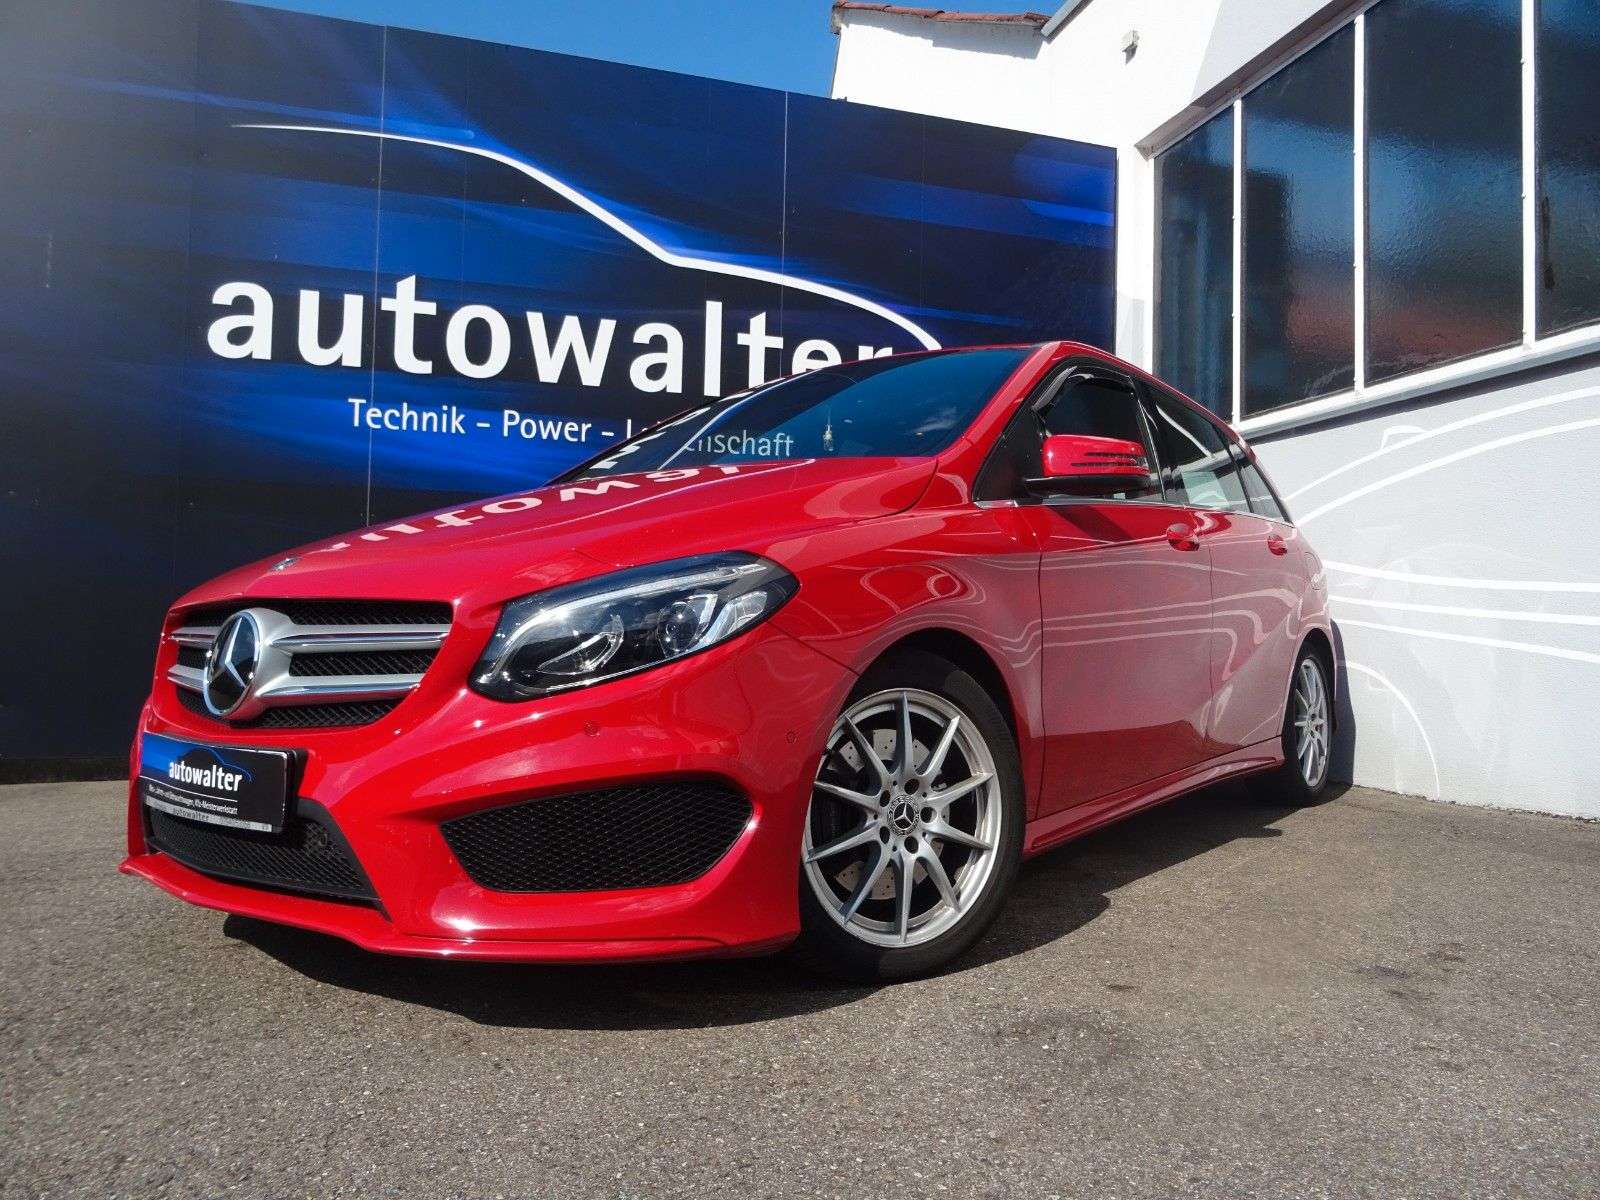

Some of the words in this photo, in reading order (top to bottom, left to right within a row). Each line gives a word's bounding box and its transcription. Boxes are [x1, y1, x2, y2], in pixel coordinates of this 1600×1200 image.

[207, 274, 893, 397] autowalte
[348, 398, 466, 434] Technik
[503, 409, 592, 442] Power
[168, 761, 243, 792] autowalter
